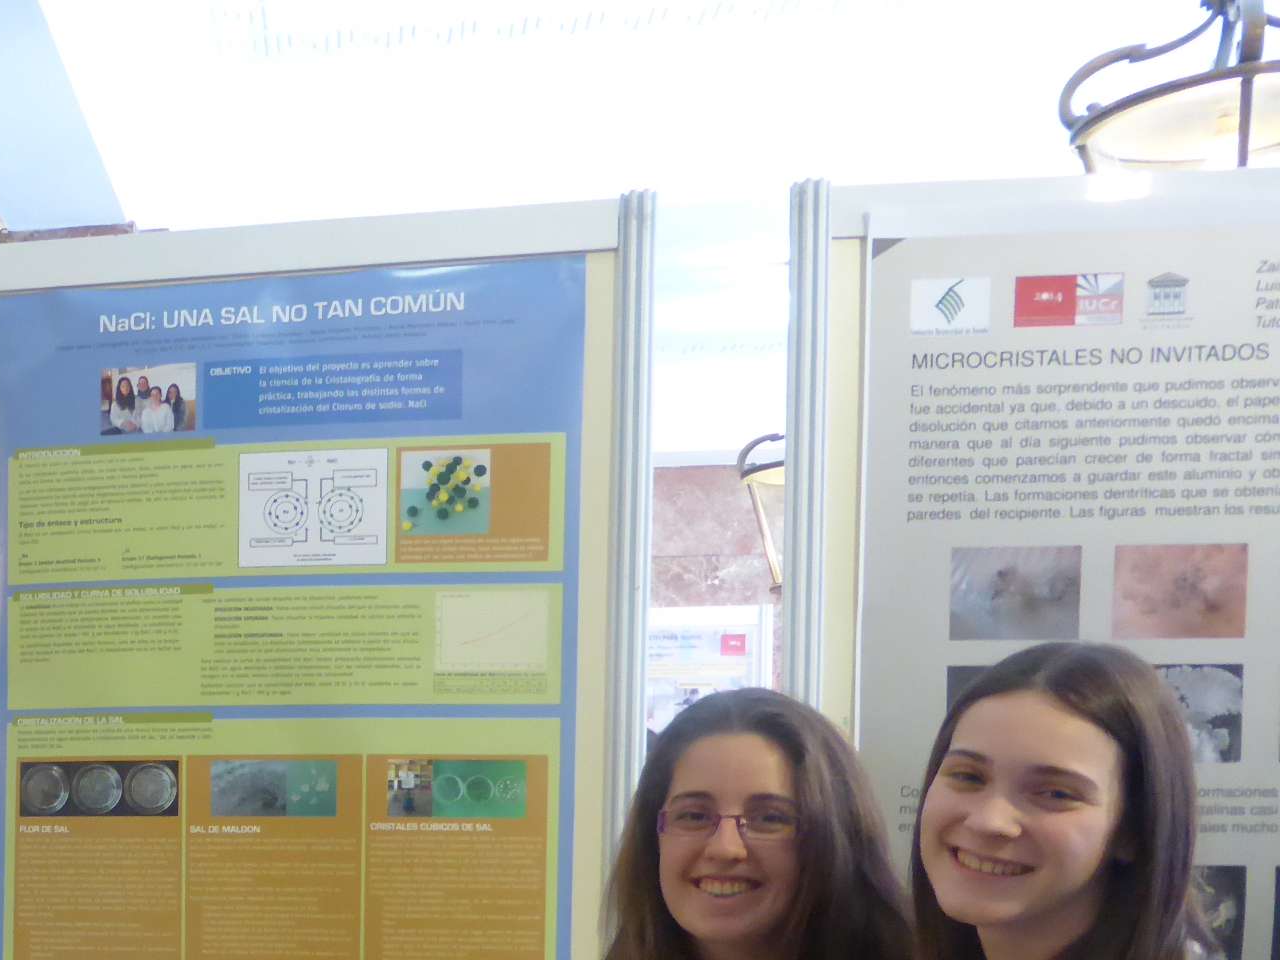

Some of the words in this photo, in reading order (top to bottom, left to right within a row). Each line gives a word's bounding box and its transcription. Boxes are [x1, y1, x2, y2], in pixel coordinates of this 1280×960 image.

[99, 312, 156, 333] NaCl:
[163, 307, 214, 329] UNA
[220, 305, 265, 326] SAL
[272, 303, 307, 323] NO
[314, 299, 364, 321] TAN
[370, 289, 465, 316] COMÚN
[322, 361, 359, 374] proyecto
[373, 359, 412, 371] aprender
[911, 348, 1102, 370] MICROCRISTALES
[1110, 347, 1143, 365] NO
[1150, 343, 1270, 364] INVITADOS
[910, 384, 924, 397] El
[928, 383, 997, 397] fenómeno
[1002, 382, 1031, 396] más
[1036, 380, 1128, 396] sorprendente
[1133, 381, 1160, 394] que
[1165, 377, 1225, 392] pudimos
[909, 403, 931, 415] fue
[935, 401, 1004, 415] accidental
[1008, 402, 1025, 416] ya
[1065, 399, 1113, 412] debido
[1117, 401, 1126, 410] a
[1131, 400, 1149, 410] un
[909, 419, 977, 433] disolución
[982, 420, 1009, 434] que
[1014, 418, 1069, 431] citamos
[1075, 415, 1170, 429] anteriormente
[908, 439, 960, 450] manera
[966, 437, 993, 452] que
[1000, 436, 1013, 449] al
[1019, 435, 1041, 449] día
[1048, 434, 1112, 450] siguiente
[1118, 432, 1178, 448] pudimos
[1185, 431, 1248, 445] observar
[908, 454, 975, 468] diferentes
[981, 455, 1009, 470] que
[1015, 453, 1077, 469] parecían
[1084, 453, 1128, 465] crecer
[1135, 451, 1153, 464] de
[1161, 450, 1201, 463] forma
[1209, 449, 1253, 462] fractal
[908, 474, 969, 486] entonces
[974, 472, 1067, 485] comenzamos
[1072, 472, 1081, 483] a
[1087, 469, 1142, 485] guardar
[1147, 469, 1177, 482] este
[1183, 467, 1242, 481] aluminio
[907, 492, 924, 503] se
[984, 489, 1009, 502] Las
[1014, 488, 1099, 501] formaciones
[1181, 486, 1208, 500] que
[1212, 486, 1229, 498] se
[906, 507, 962, 523] paredes
[969, 507, 990, 520] del
[1069, 505, 1095, 518] Las
[1098, 505, 1147, 521] figuras
[1154, 504, 1220, 517] muestran
[1224, 503, 1245, 516] los
